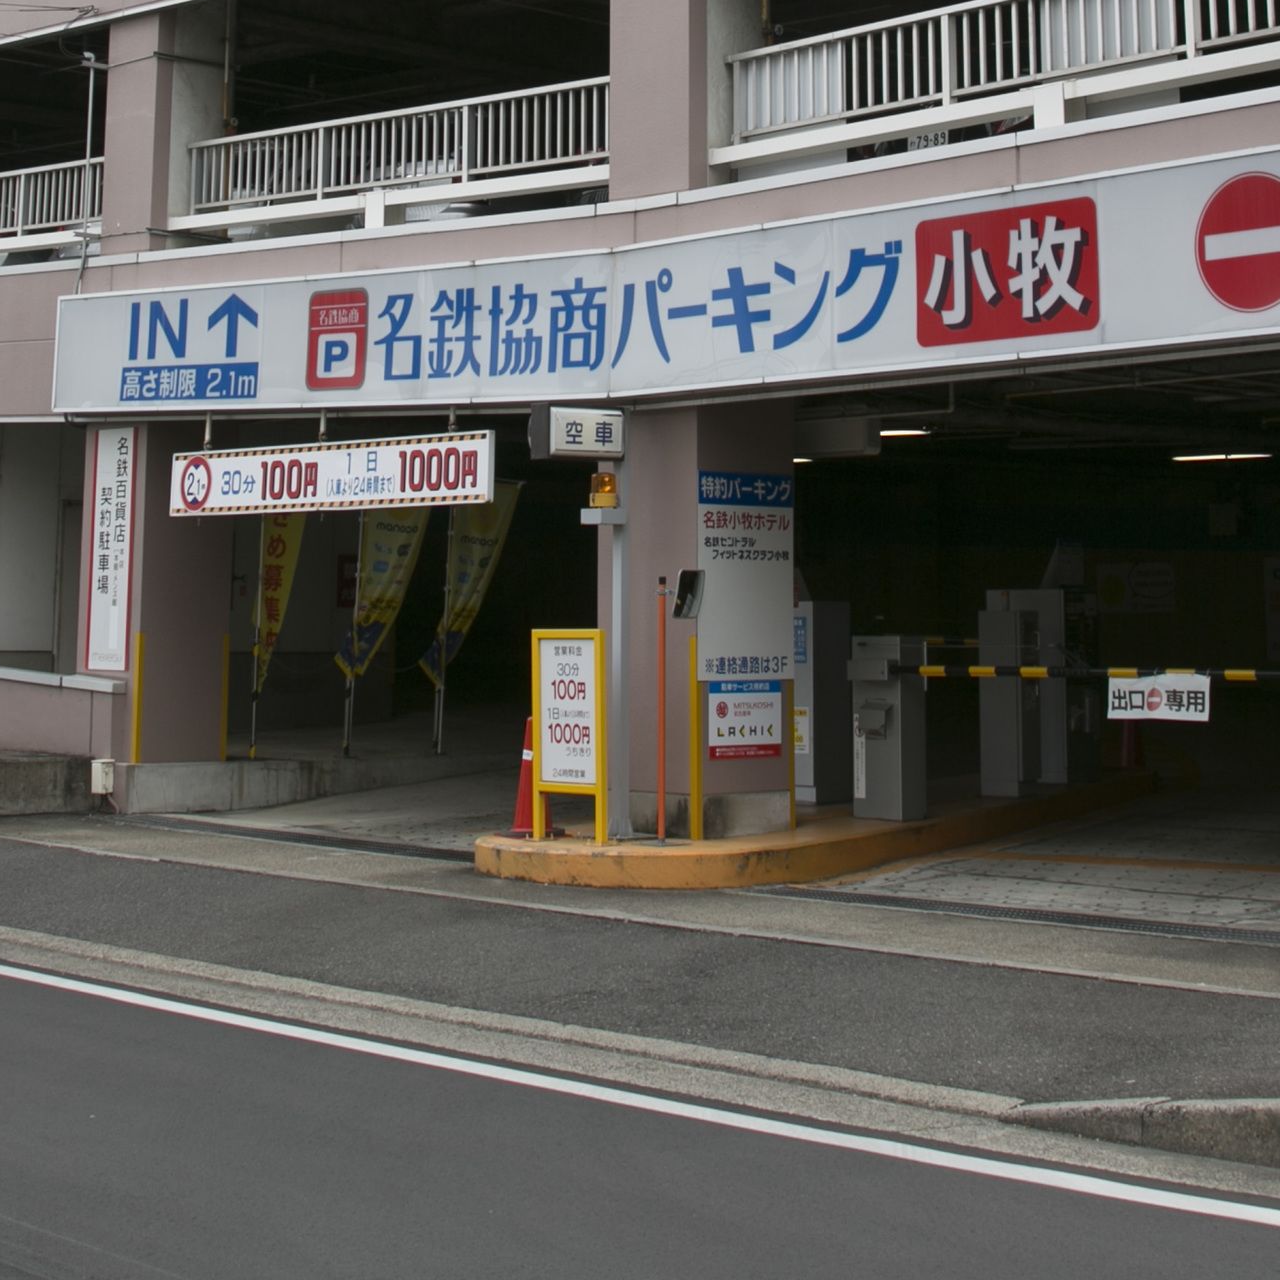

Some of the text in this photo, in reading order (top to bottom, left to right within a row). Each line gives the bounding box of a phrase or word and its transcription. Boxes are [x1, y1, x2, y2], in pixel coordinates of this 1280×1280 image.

[923, 215, 1088, 327] 小牧
[319, 307, 359, 326] 名鉄協商
[373, 239, 903, 380] 名鉄協商パーキング
[128, 298, 189, 360] IN
[323, 340, 349, 373] P
[122, 368, 255, 399] 高さ制限 2.1m
[565, 419, 615, 448] 空車
[221, 459, 318, 500] 30分 100円
[399, 446, 478, 492] 1000円
[114, 436, 129, 543] 名鉄百貨店
[701, 476, 791, 500] 特約パーキング
[704, 511, 790, 531] 名鉄小牧ホテル
[97, 487, 112, 594] 契約駐車場
[557, 663, 579, 677] 30分
[551, 680, 586, 700] 100円
[1111, 688, 1206, 713] 出口 専用
[548, 723, 590, 744] 1000円
